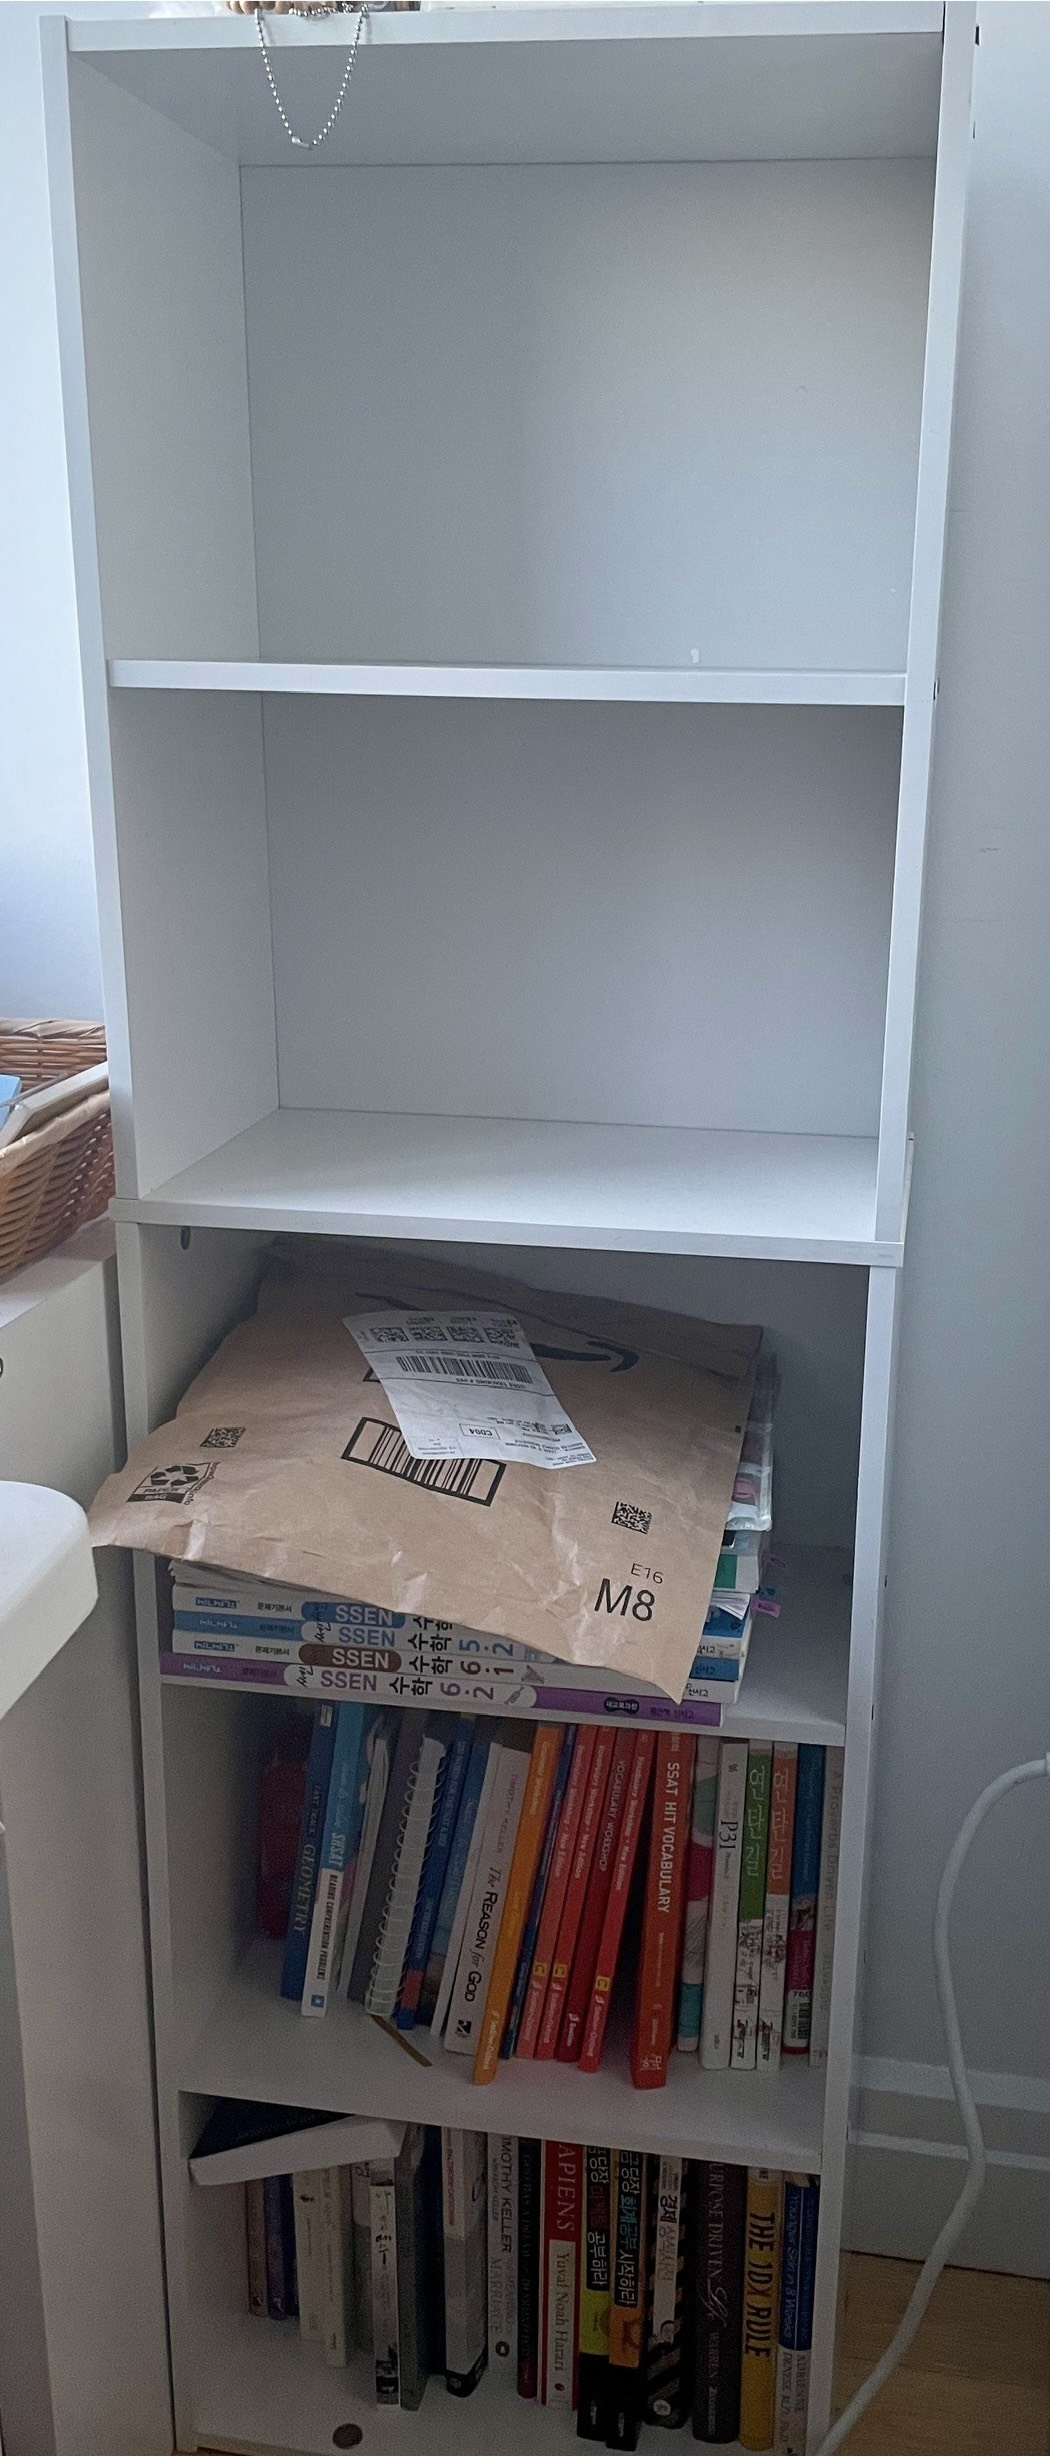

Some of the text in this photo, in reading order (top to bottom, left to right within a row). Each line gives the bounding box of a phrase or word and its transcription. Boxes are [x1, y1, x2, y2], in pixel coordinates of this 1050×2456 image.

[631, 1563, 664, 1584] E16
[335, 1605, 393, 1626] SSEN
[594, 1578, 656, 1622] M8
[338, 1627, 396, 1647] SSEN
[407, 1633, 452, 1653] 수학
[320, 1670, 378, 1692] SSEN
[389, 1676, 433, 1697] 수학
[332, 1649, 389, 1669] SSEN
[409, 1655, 453, 1675] 수학
[664, 1761, 680, 1795] SSAT
[497, 1773, 518, 1854] TIMOTHY KELLER
[599, 1758, 626, 1872] VOCABULARY WORKSHOP
[663, 1801, 676, 1822] HIT
[328, 1832, 345, 1868] SHSAT
[718, 1820, 738, 1850] P31
[294, 1843, 316, 1935] GEOMETRY
[657, 1826, 675, 1913] VOCABULARY
[465, 1866, 501, 2003] The REASON for GOD
[587, 2147, 608, 2184] 금당장
[618, 2151, 641, 2194] 금당장
[500, 2137, 511, 2253] IMOTHY KELLER
[555, 2144, 578, 2231] APIENS
[659, 2194, 678, 2223] 경제
[708, 2163, 724, 2217] URPOSE
[555, 2252, 569, 2287] Yuval
[586, 2230, 607, 2285] 공부하라
[706, 2222, 723, 2279] DRIVEN
[614, 2250, 637, 2304] 시작하라
[744, 2211, 774, 2357] THE 10X RULE
[554, 2292, 569, 2324] Noah
[782, 2298, 795, 2339] Weeks
[707, 2331, 720, 2378] WARREN
